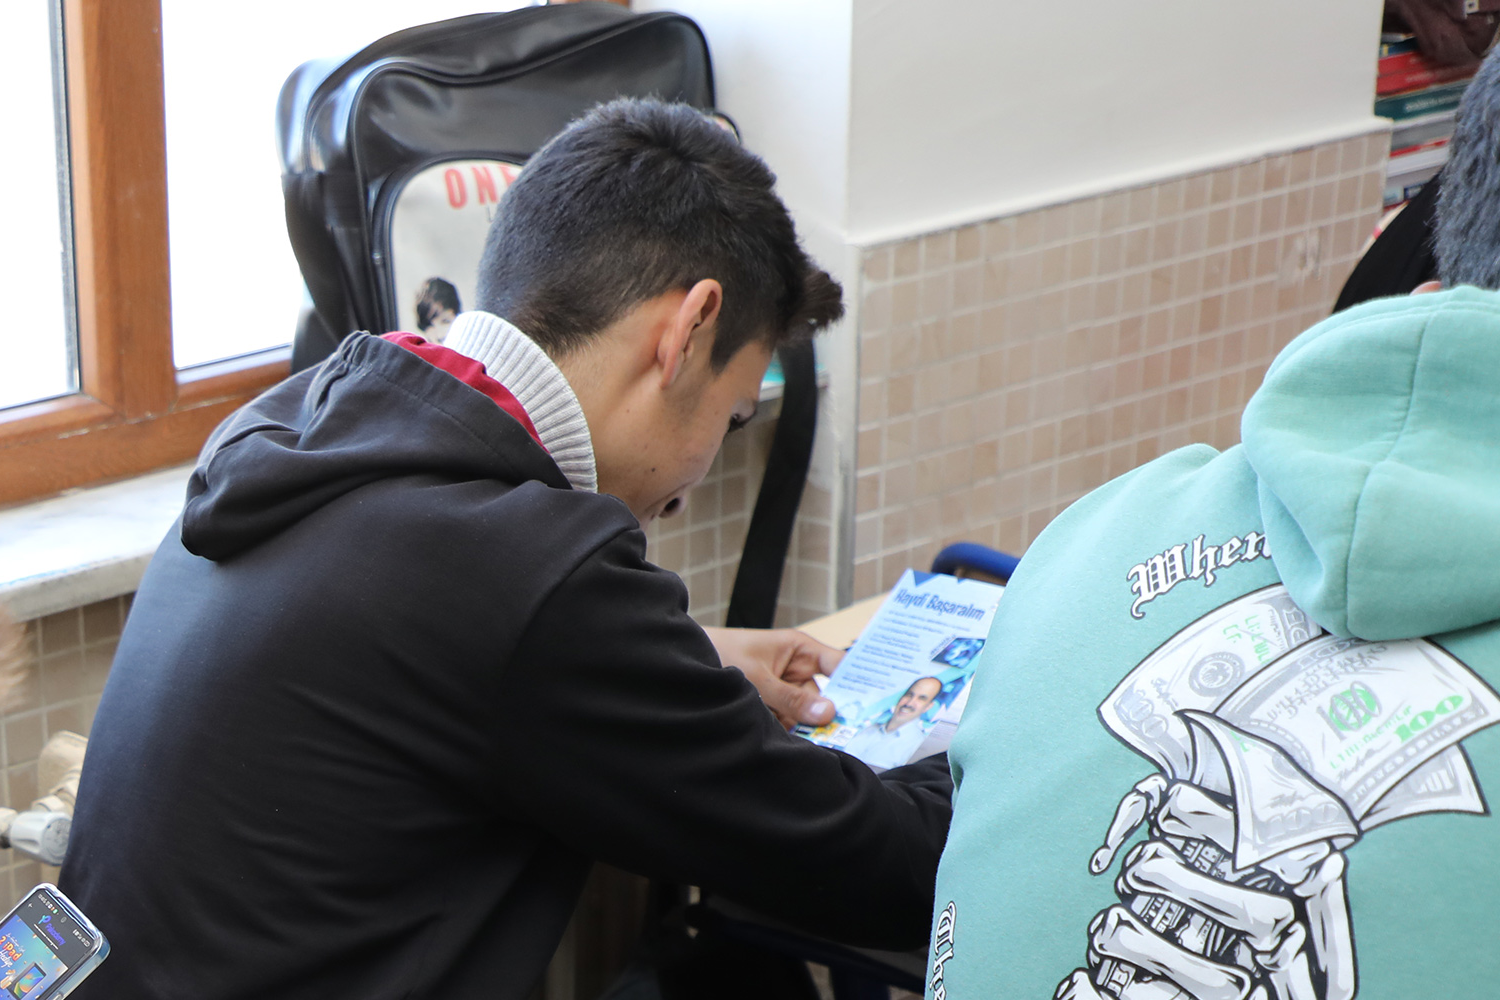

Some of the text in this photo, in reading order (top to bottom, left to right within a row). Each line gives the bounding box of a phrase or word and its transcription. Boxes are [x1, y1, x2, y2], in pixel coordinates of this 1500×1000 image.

[1126, 531, 1272, 619] When
[926, 595, 986, 621] Başaralım
[1393, 694, 1464, 743] 100
[2, 941, 23, 961] iPad
